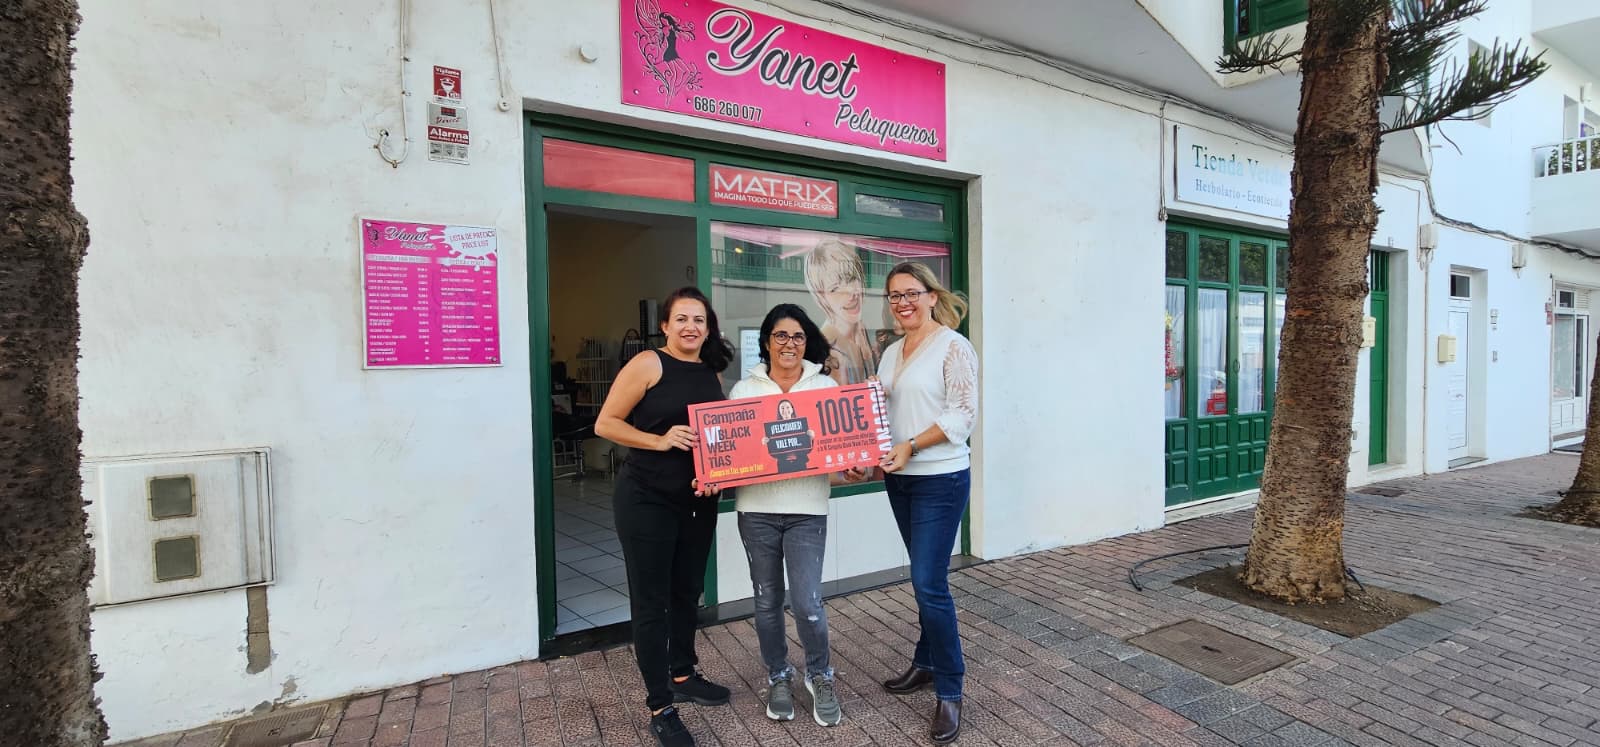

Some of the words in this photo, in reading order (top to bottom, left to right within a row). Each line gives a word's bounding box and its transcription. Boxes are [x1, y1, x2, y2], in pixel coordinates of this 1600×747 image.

[706, 8, 859, 100] Yanet
[693, 96, 716, 114] 686
[719, 101, 740, 118] 260
[742, 105, 762, 122] 077
[430, 127, 469, 140] Alarma
[834, 103, 938, 147] Peluqueros
[1192, 144, 1244, 176] Tienda
[714, 171, 833, 204] MATRIX
[1195, 179, 1241, 199] Herbolario
[714, 192, 746, 201] IMAGINA
[748, 195, 767, 204] TODO
[768, 197, 777, 205] LO
[778, 198, 793, 207] QUE
[384, 227, 429, 242] Yanet
[703, 409, 756, 425] Campaña
[816, 394, 869, 436] 100€
[718, 426, 751, 441] BLACK
[707, 440, 736, 454] WEEK
[775, 439, 787, 449] VALE
